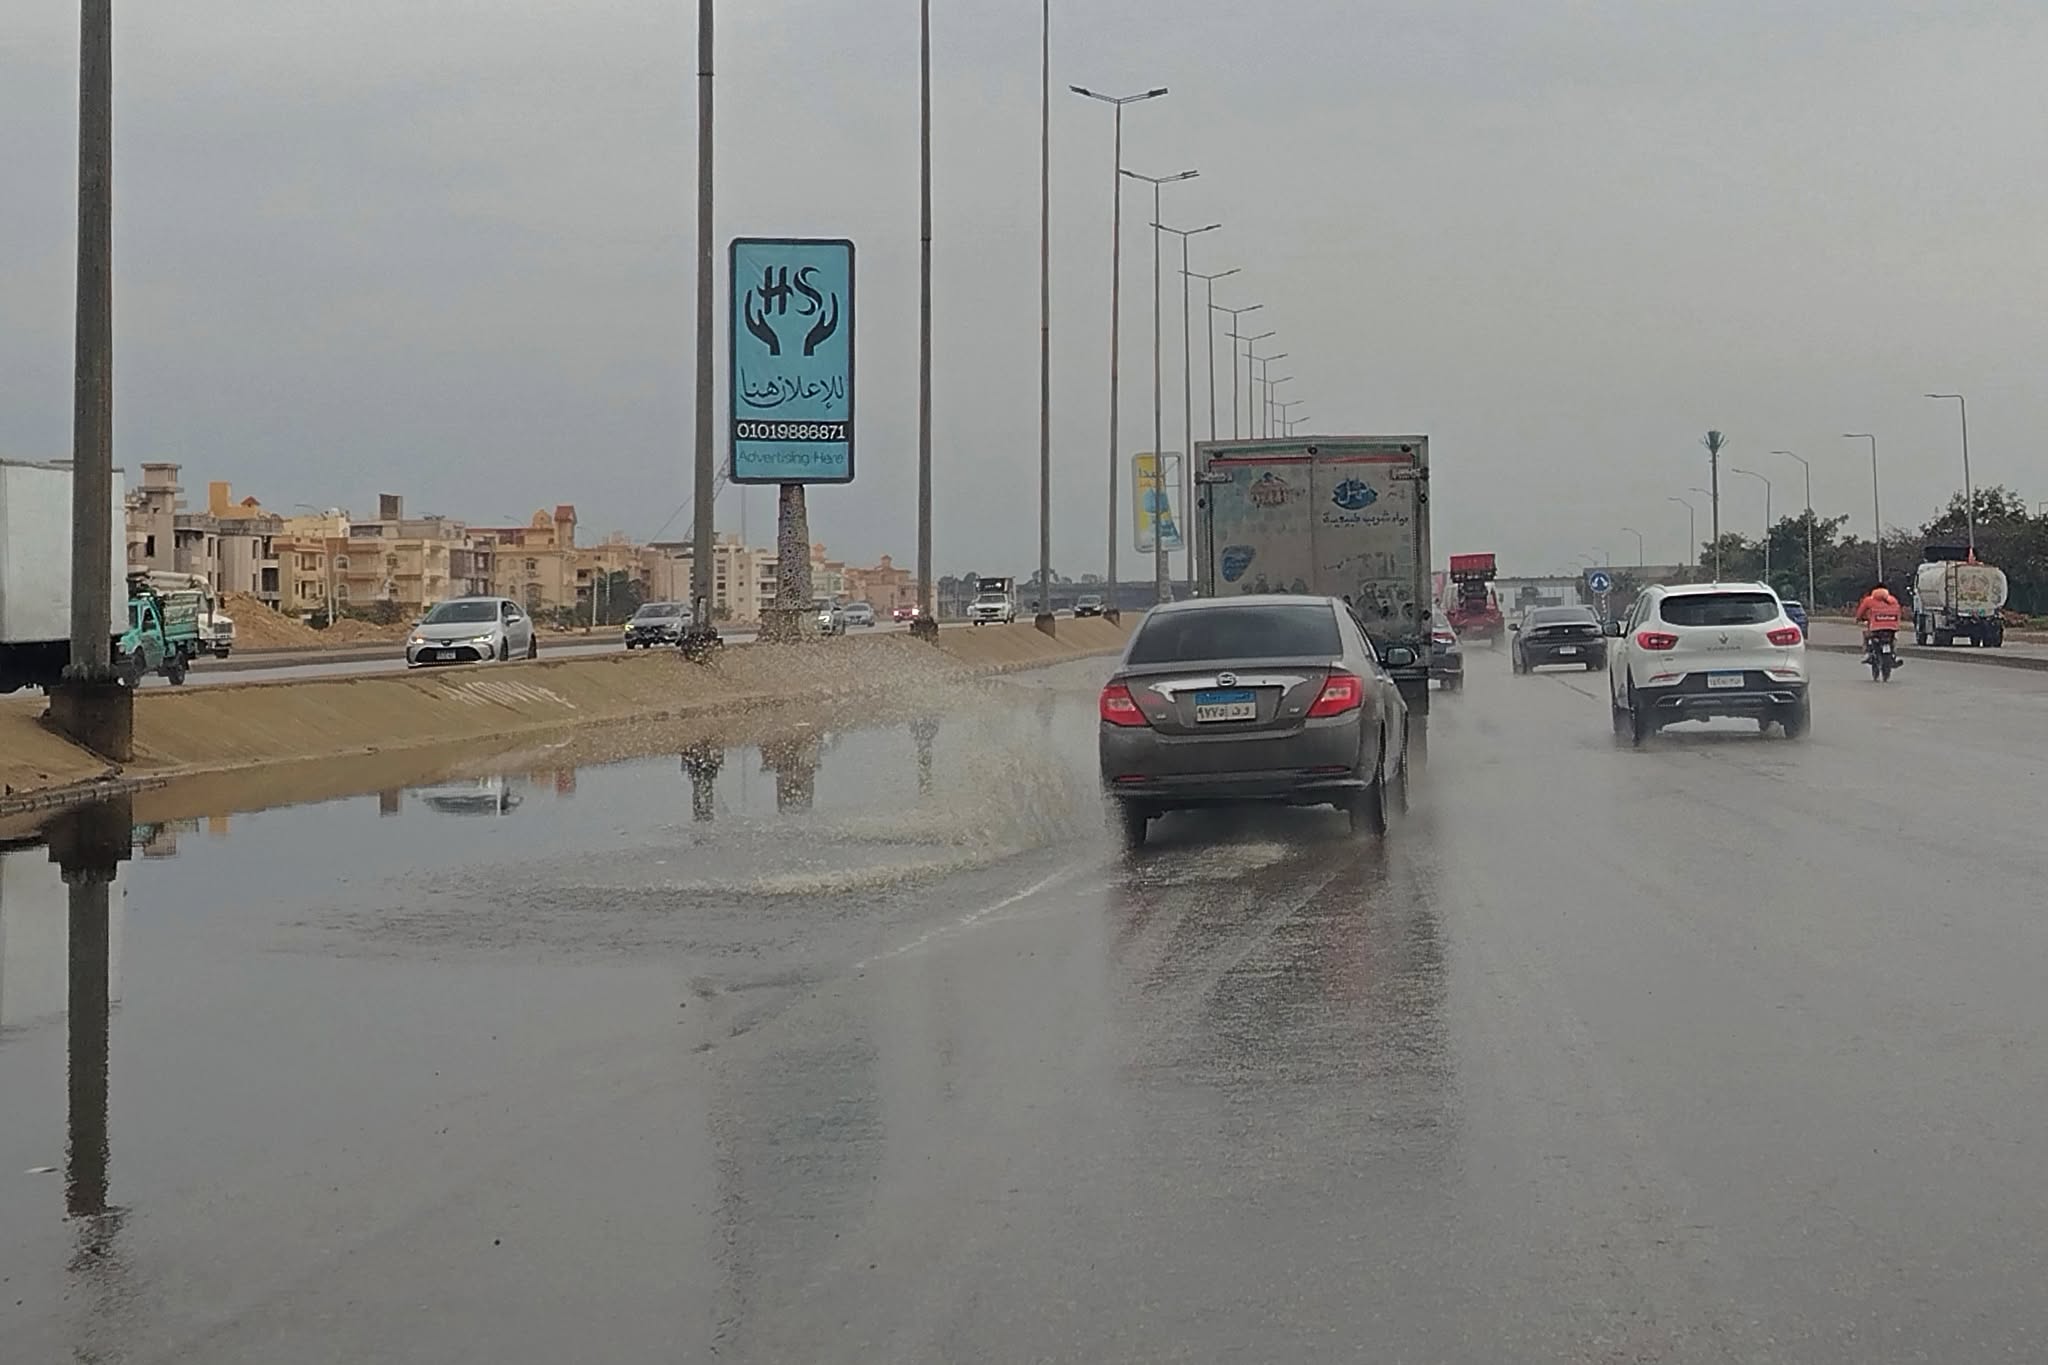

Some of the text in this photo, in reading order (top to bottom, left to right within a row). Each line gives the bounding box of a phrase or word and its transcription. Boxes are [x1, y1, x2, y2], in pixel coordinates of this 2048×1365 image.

[757, 266, 822, 316] HS
[741, 366, 780, 399] هنا
[737, 423, 846, 440] 01019886871
[739, 451, 845, 467] Advertising Here
